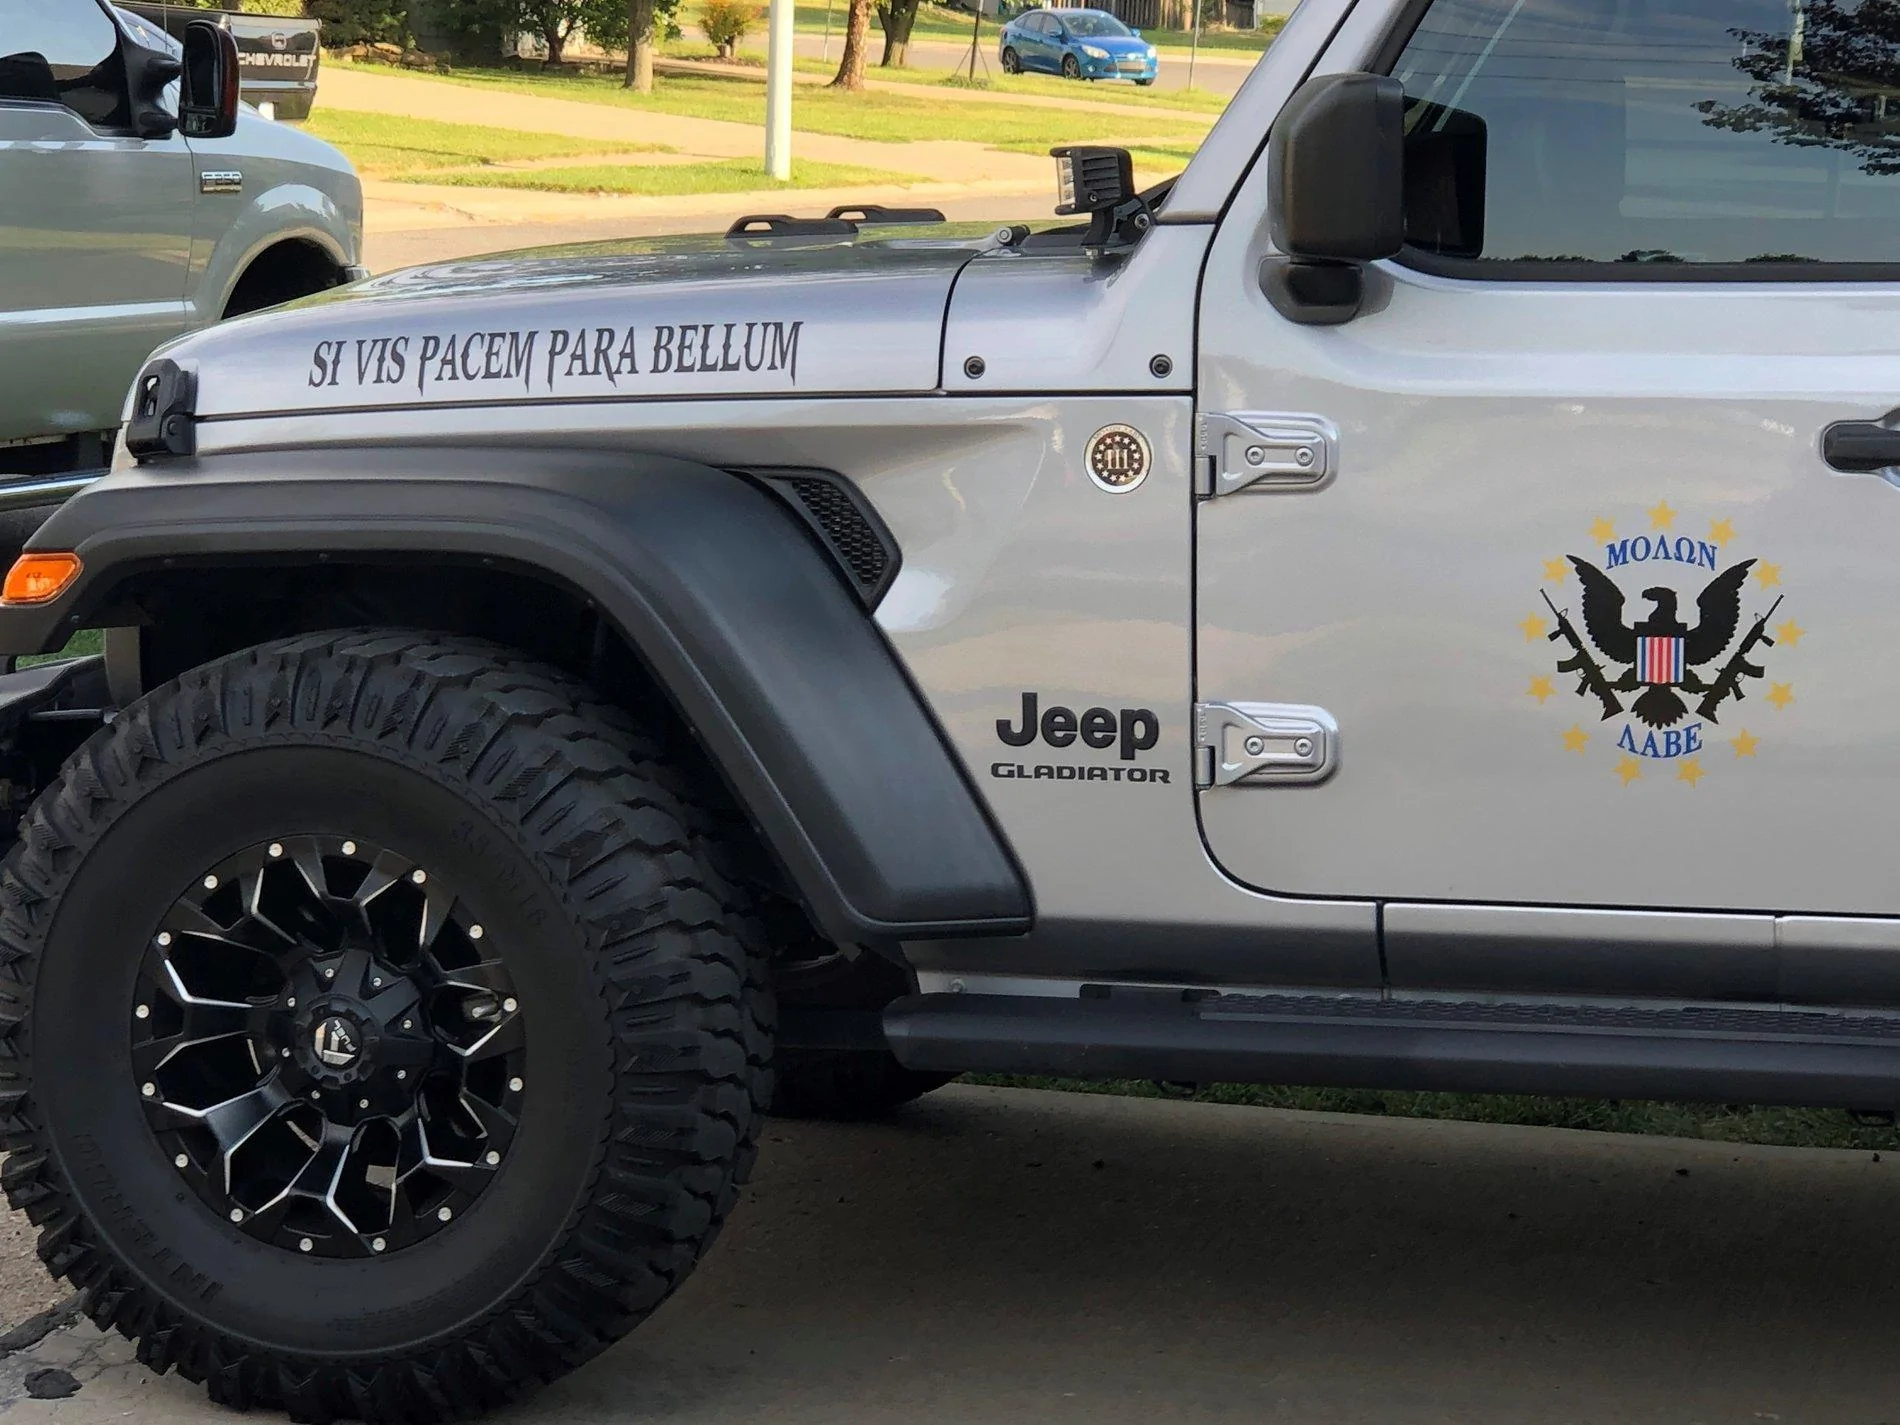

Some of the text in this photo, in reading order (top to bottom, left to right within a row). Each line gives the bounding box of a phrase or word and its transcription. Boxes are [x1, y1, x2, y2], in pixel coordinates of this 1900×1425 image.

[238, 52, 316, 67] CHEVROLET
[308, 321, 804, 397] SI VIS PACEM PARA BELLUM
[996, 692, 1160, 760] Jeep
[991, 763, 1171, 784] GLADIATOR
